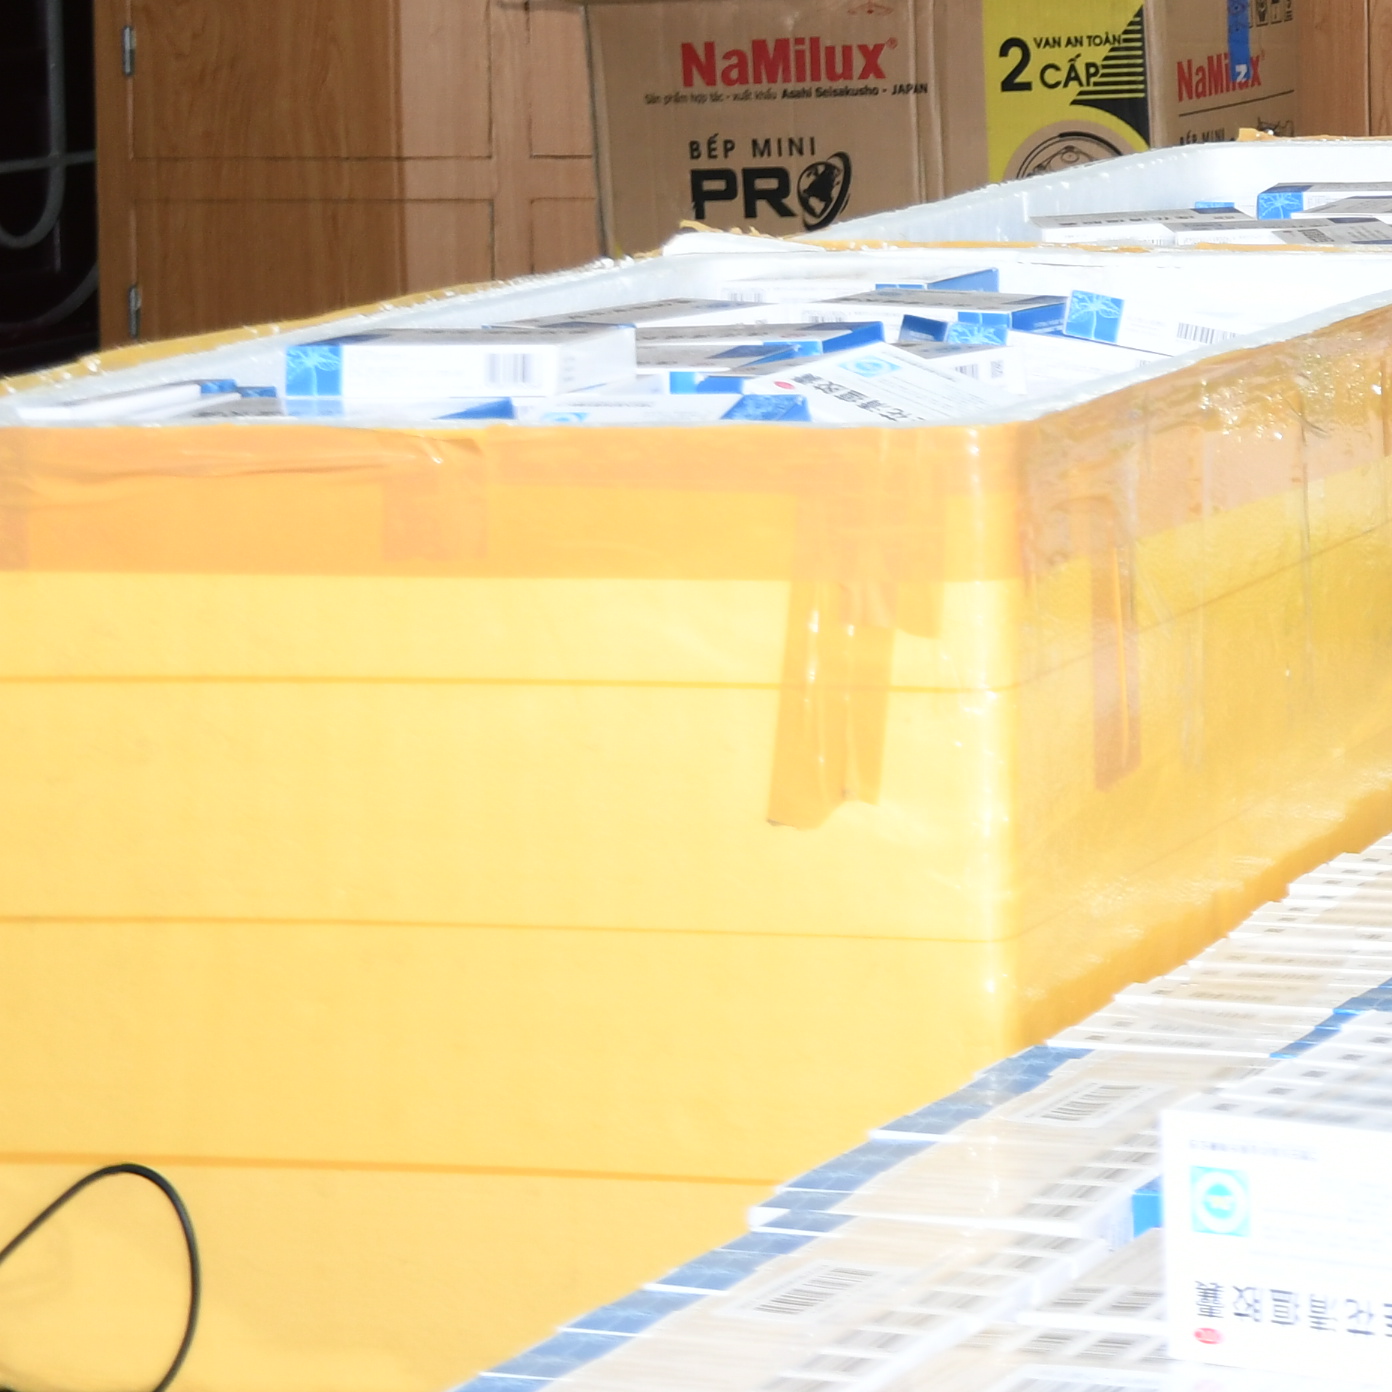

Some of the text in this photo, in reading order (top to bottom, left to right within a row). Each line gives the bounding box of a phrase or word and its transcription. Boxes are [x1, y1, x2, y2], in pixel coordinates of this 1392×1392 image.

[1033, 32, 1122, 49] VAN AN TOÀN
[998, 37, 1032, 92] 2
[1039, 53, 1101, 89] CẤP
[781, 87, 812, 100] Asahi
[891, 83, 928, 96] JAPAN
[689, 132, 816, 160] BẾP MINI
